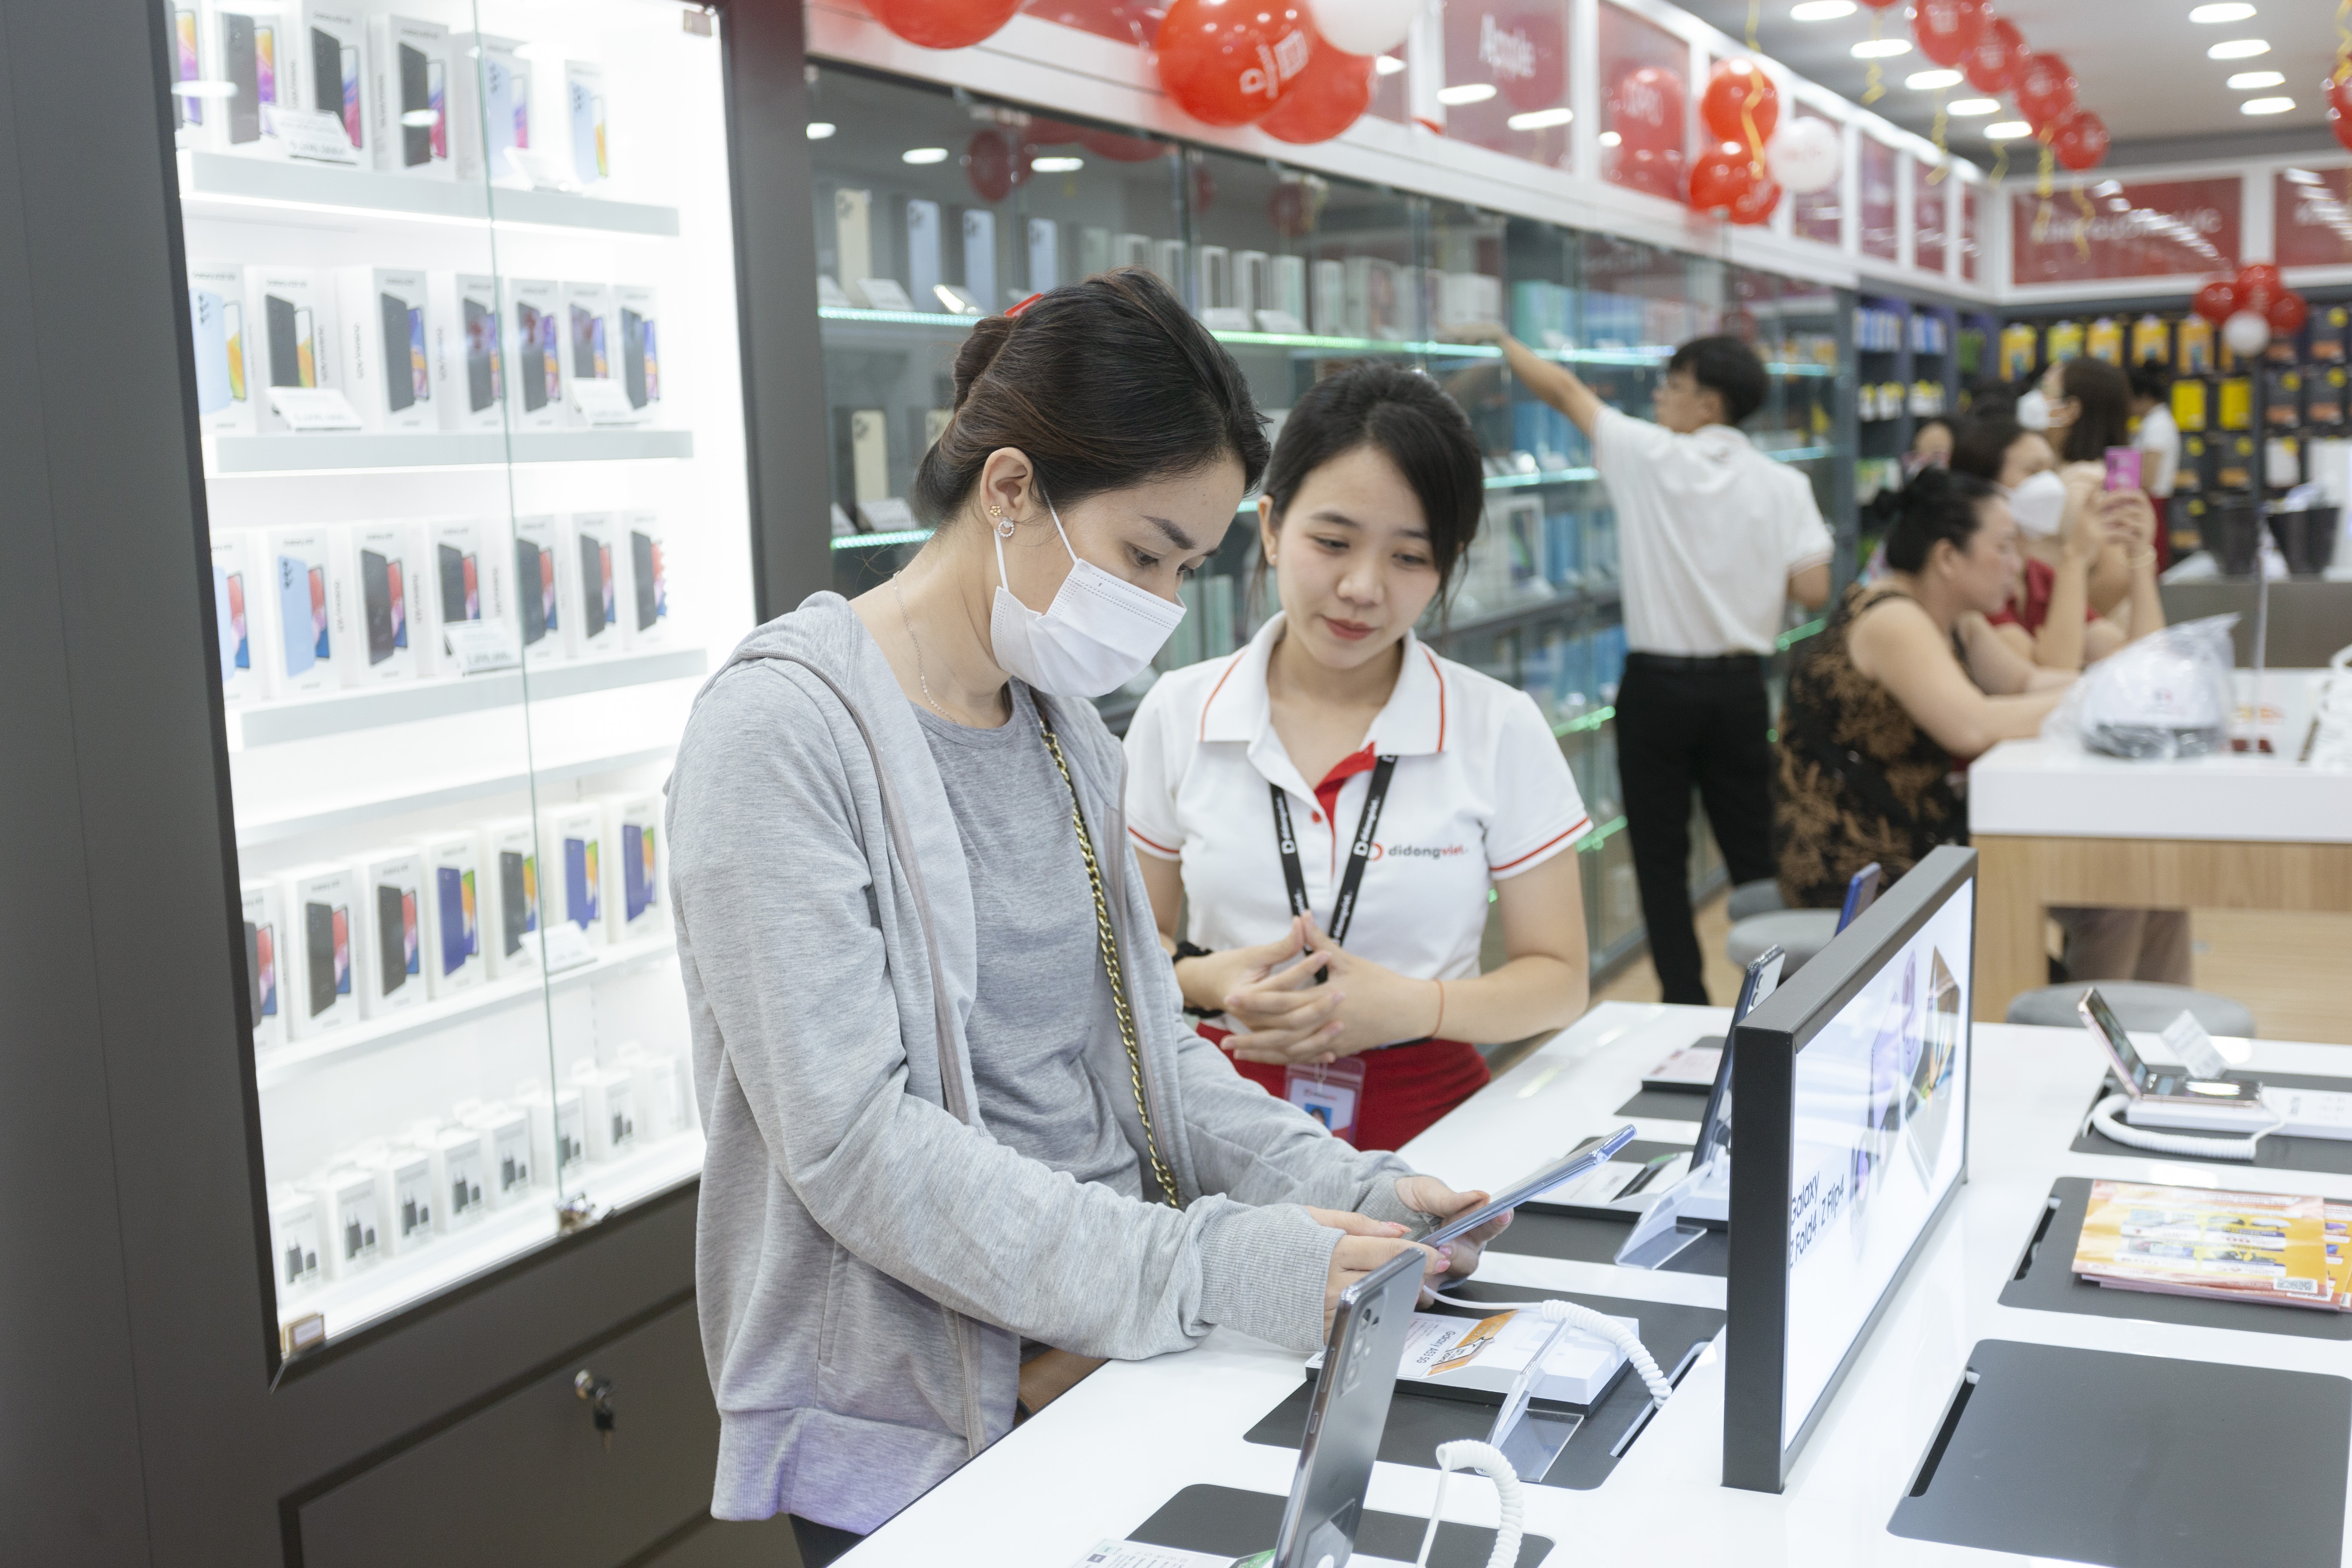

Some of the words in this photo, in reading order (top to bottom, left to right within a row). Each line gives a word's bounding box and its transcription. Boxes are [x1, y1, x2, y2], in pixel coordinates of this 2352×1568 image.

[1791, 1170, 1820, 1227] Galaxy
[1795, 1209, 1817, 1262] Fold4
[1821, 1197, 1826, 1228] Z
[1827, 1173, 1844, 1219] Flip4
[1423, 1347, 1439, 1357] A53
[1430, 1331, 1456, 1348] Galaxy
